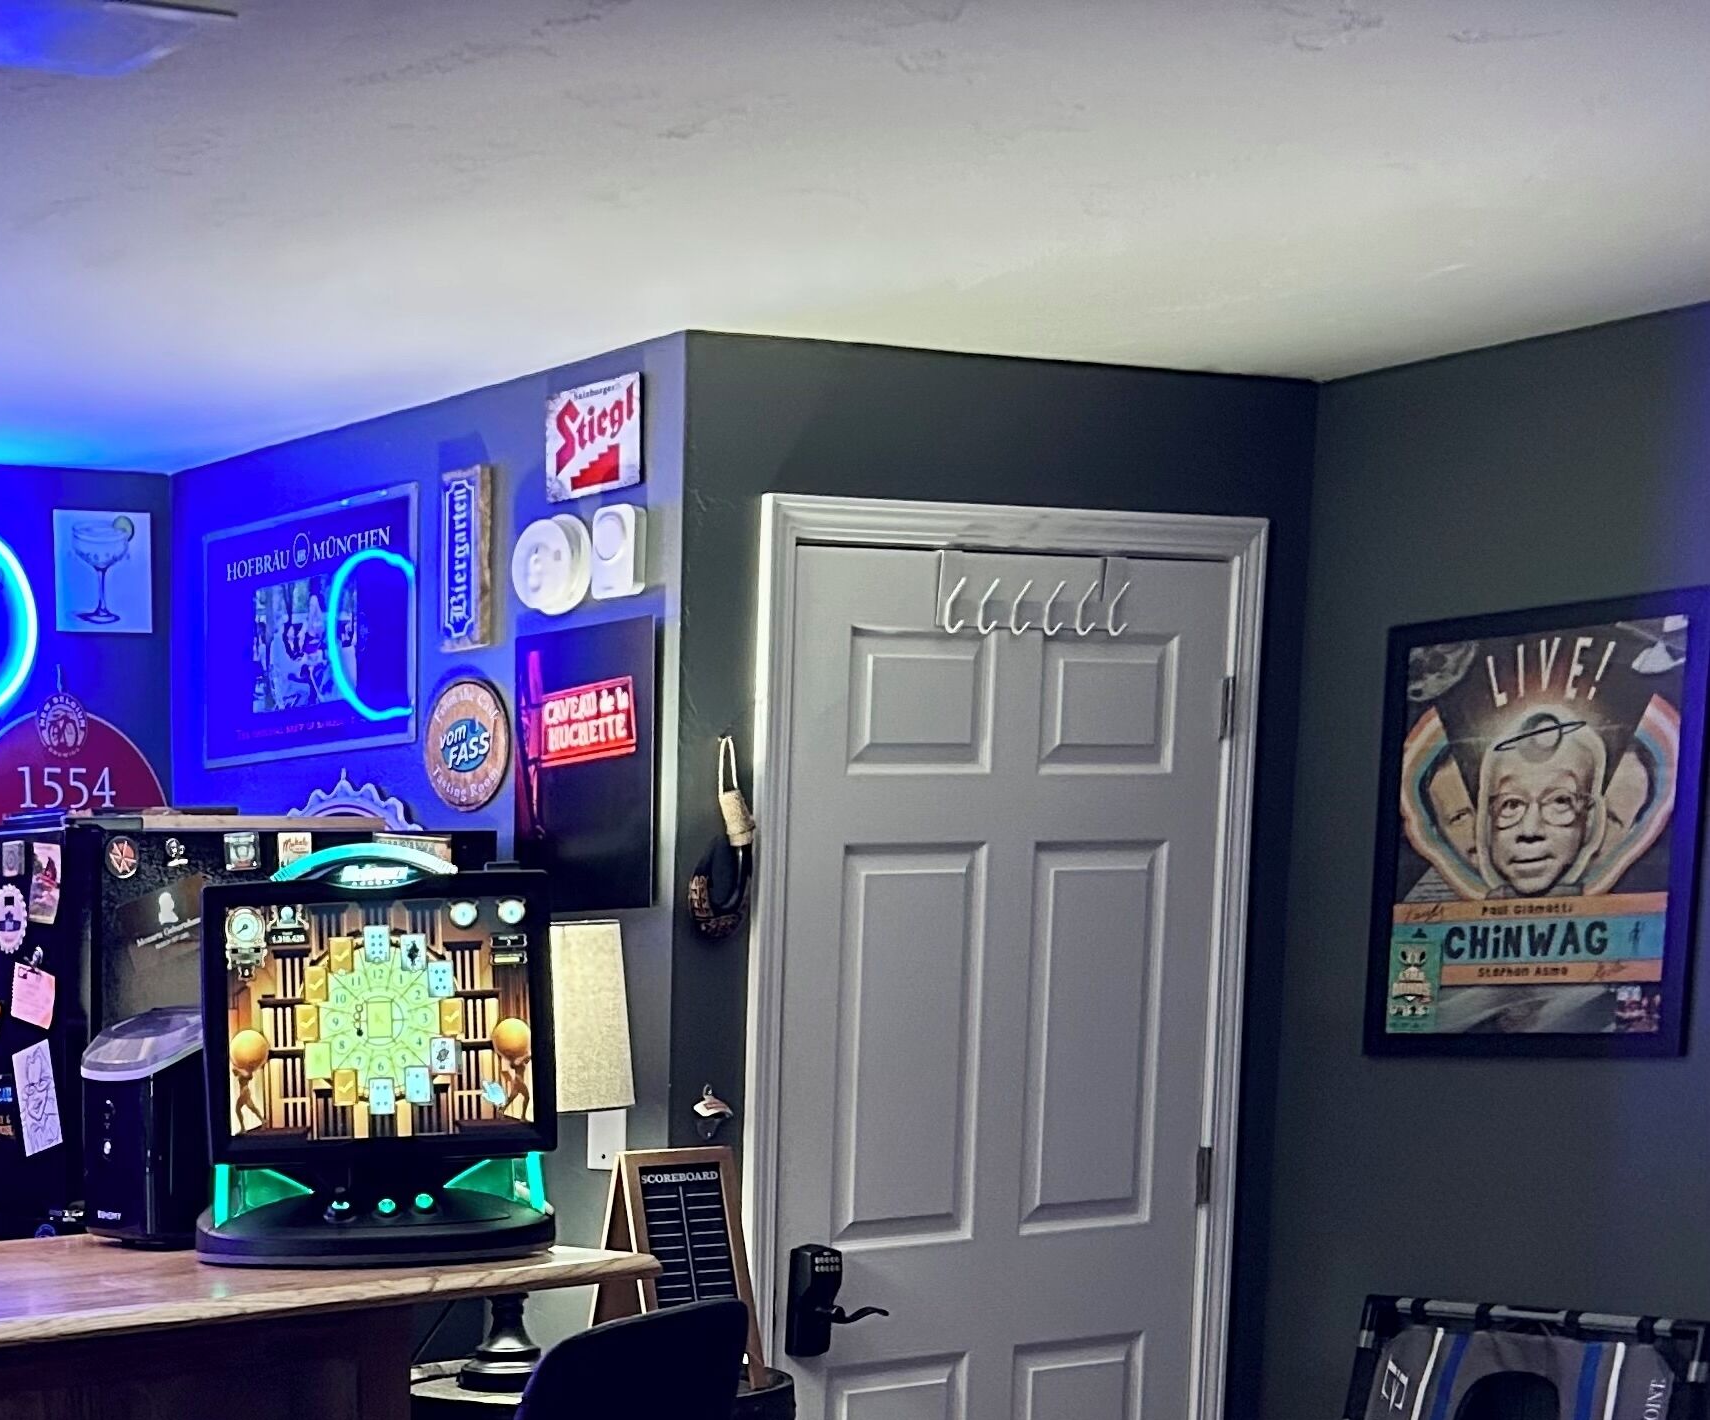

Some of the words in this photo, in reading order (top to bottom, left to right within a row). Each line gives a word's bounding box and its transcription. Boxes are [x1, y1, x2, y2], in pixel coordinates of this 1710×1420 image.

[555, 381, 635, 476] Stiegl
[225, 549, 291, 583] HOFBRÄU
[312, 525, 392, 563] MÜNCHEN
[449, 486, 472, 624] Biergarten
[1486, 636, 1617, 708] LIVE!
[543, 690, 598, 726] CAVEAU
[599, 688, 615, 714] de
[615, 686, 630, 711] la
[439, 724, 467, 751] vom
[447, 731, 491, 769] FASS
[547, 712, 628, 753] HUCHETTE
[16, 765, 117, 809] 1554
[432, 765, 468, 803] Tasting
[469, 770, 500, 799] Room
[349, 975, 363, 987] 11
[370, 968, 385, 980] 12
[334, 993, 347, 1005] 10
[640, 1170, 719, 1185] SCOREBOARD
